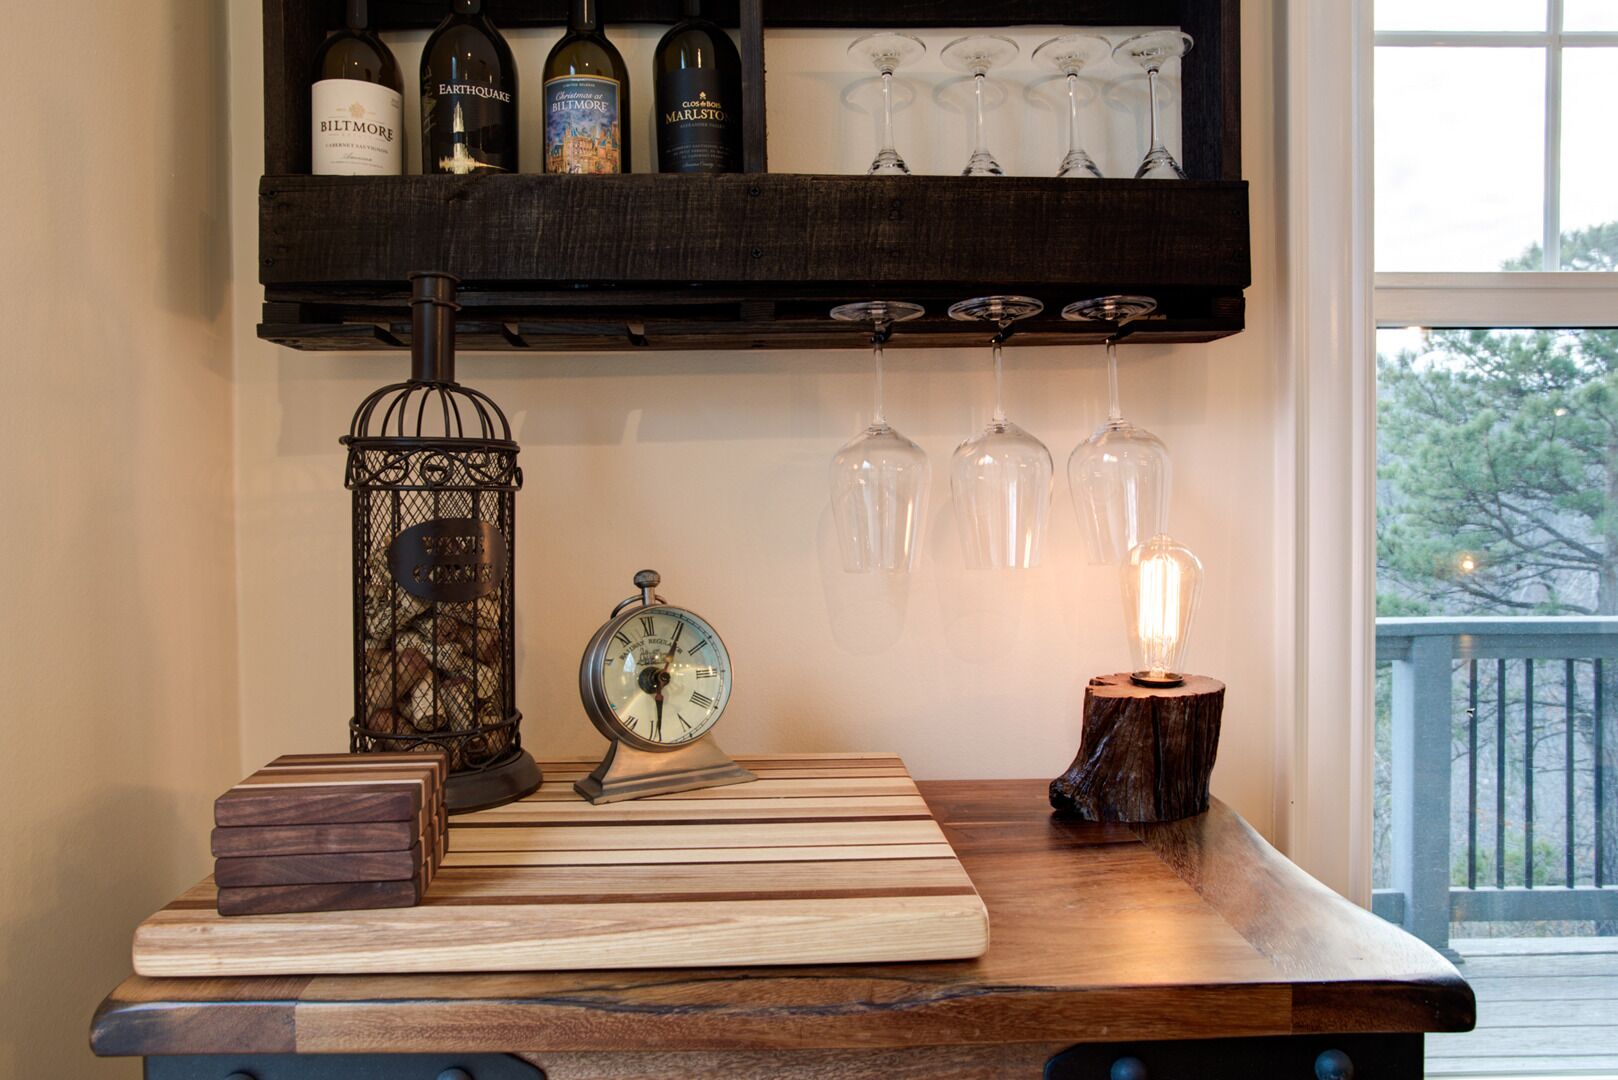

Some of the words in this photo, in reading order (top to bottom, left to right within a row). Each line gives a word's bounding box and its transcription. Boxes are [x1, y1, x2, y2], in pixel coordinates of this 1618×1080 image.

[439, 83, 511, 104] EARTHQUAKE
[555, 91, 593, 101] Christmas
[552, 99, 609, 113] BILTMORE
[320, 120, 394, 142] BILTMORE
